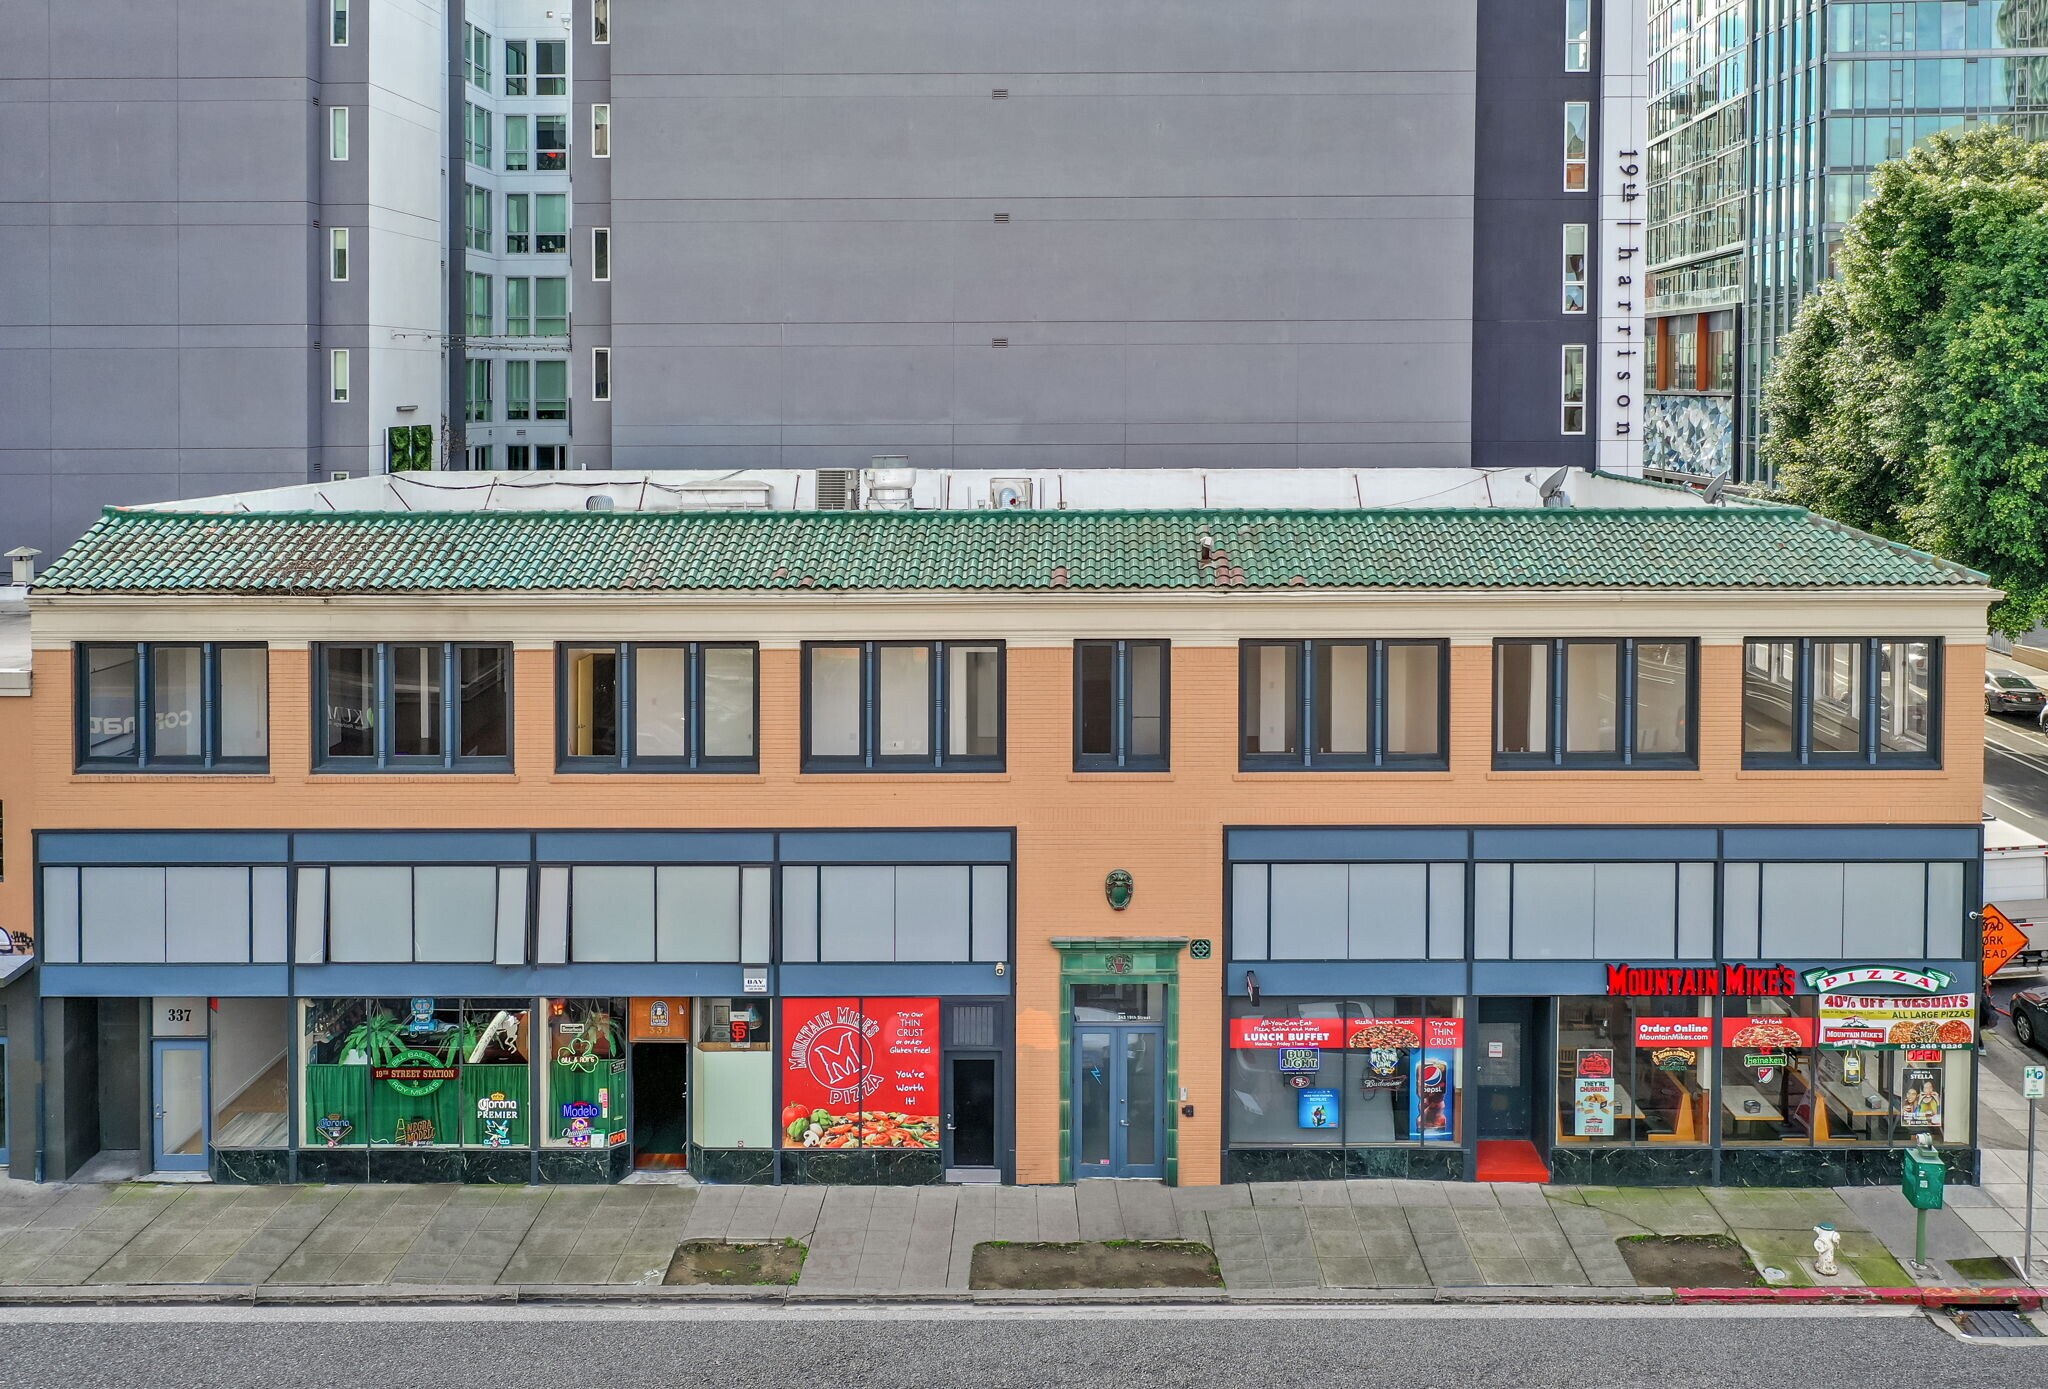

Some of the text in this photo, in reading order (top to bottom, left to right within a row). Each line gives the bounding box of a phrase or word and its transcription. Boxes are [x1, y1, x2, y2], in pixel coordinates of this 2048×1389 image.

[1617, 150, 1639, 437] 19th harrison
[1982, 936, 2004, 946] ORK
[1823, 970, 1931, 988] PIZZA
[1824, 996, 1856, 1009] 40%
[1891, 995, 1969, 1009] TUESDAYS
[168, 1008, 191, 1021] 337
[1892, 1011, 1908, 1019] ALL
[1911, 1010, 1938, 1018] LARGE
[1940, 1010, 1971, 1018] PIZZAS
[900, 1019, 921, 1027] THIN
[897, 1028, 924, 1037] CRUST
[1433, 1028, 1454, 1036] THIN
[1640, 1024, 1708, 1033] Order Online
[1244, 1033, 1330, 1041] LUNCH BUFFET
[1429, 1037, 1457, 1046] CRUST
[1639, 1033, 1708, 1041] MountainMikes.com
[1286, 1049, 1313, 1060] BUD
[1908, 1050, 1940, 1061] OPEN
[1281, 1058, 1318, 1069] LIGHT
[1747, 1056, 1784, 1064] Heineken
[391, 1070, 420, 1078] STREET
[422, 1070, 454, 1078] STATION
[896, 1070, 925, 1079] You're
[391, 1082, 408, 1093] ROY
[829, 1073, 884, 1105] PIZZA
[478, 1098, 517, 1111] Corona
[477, 1111, 518, 1119] PREMIER
[563, 1105, 598, 1117] Modelo
[319, 1118, 349, 1128] Corona
[610, 1133, 625, 1145] OPEN
